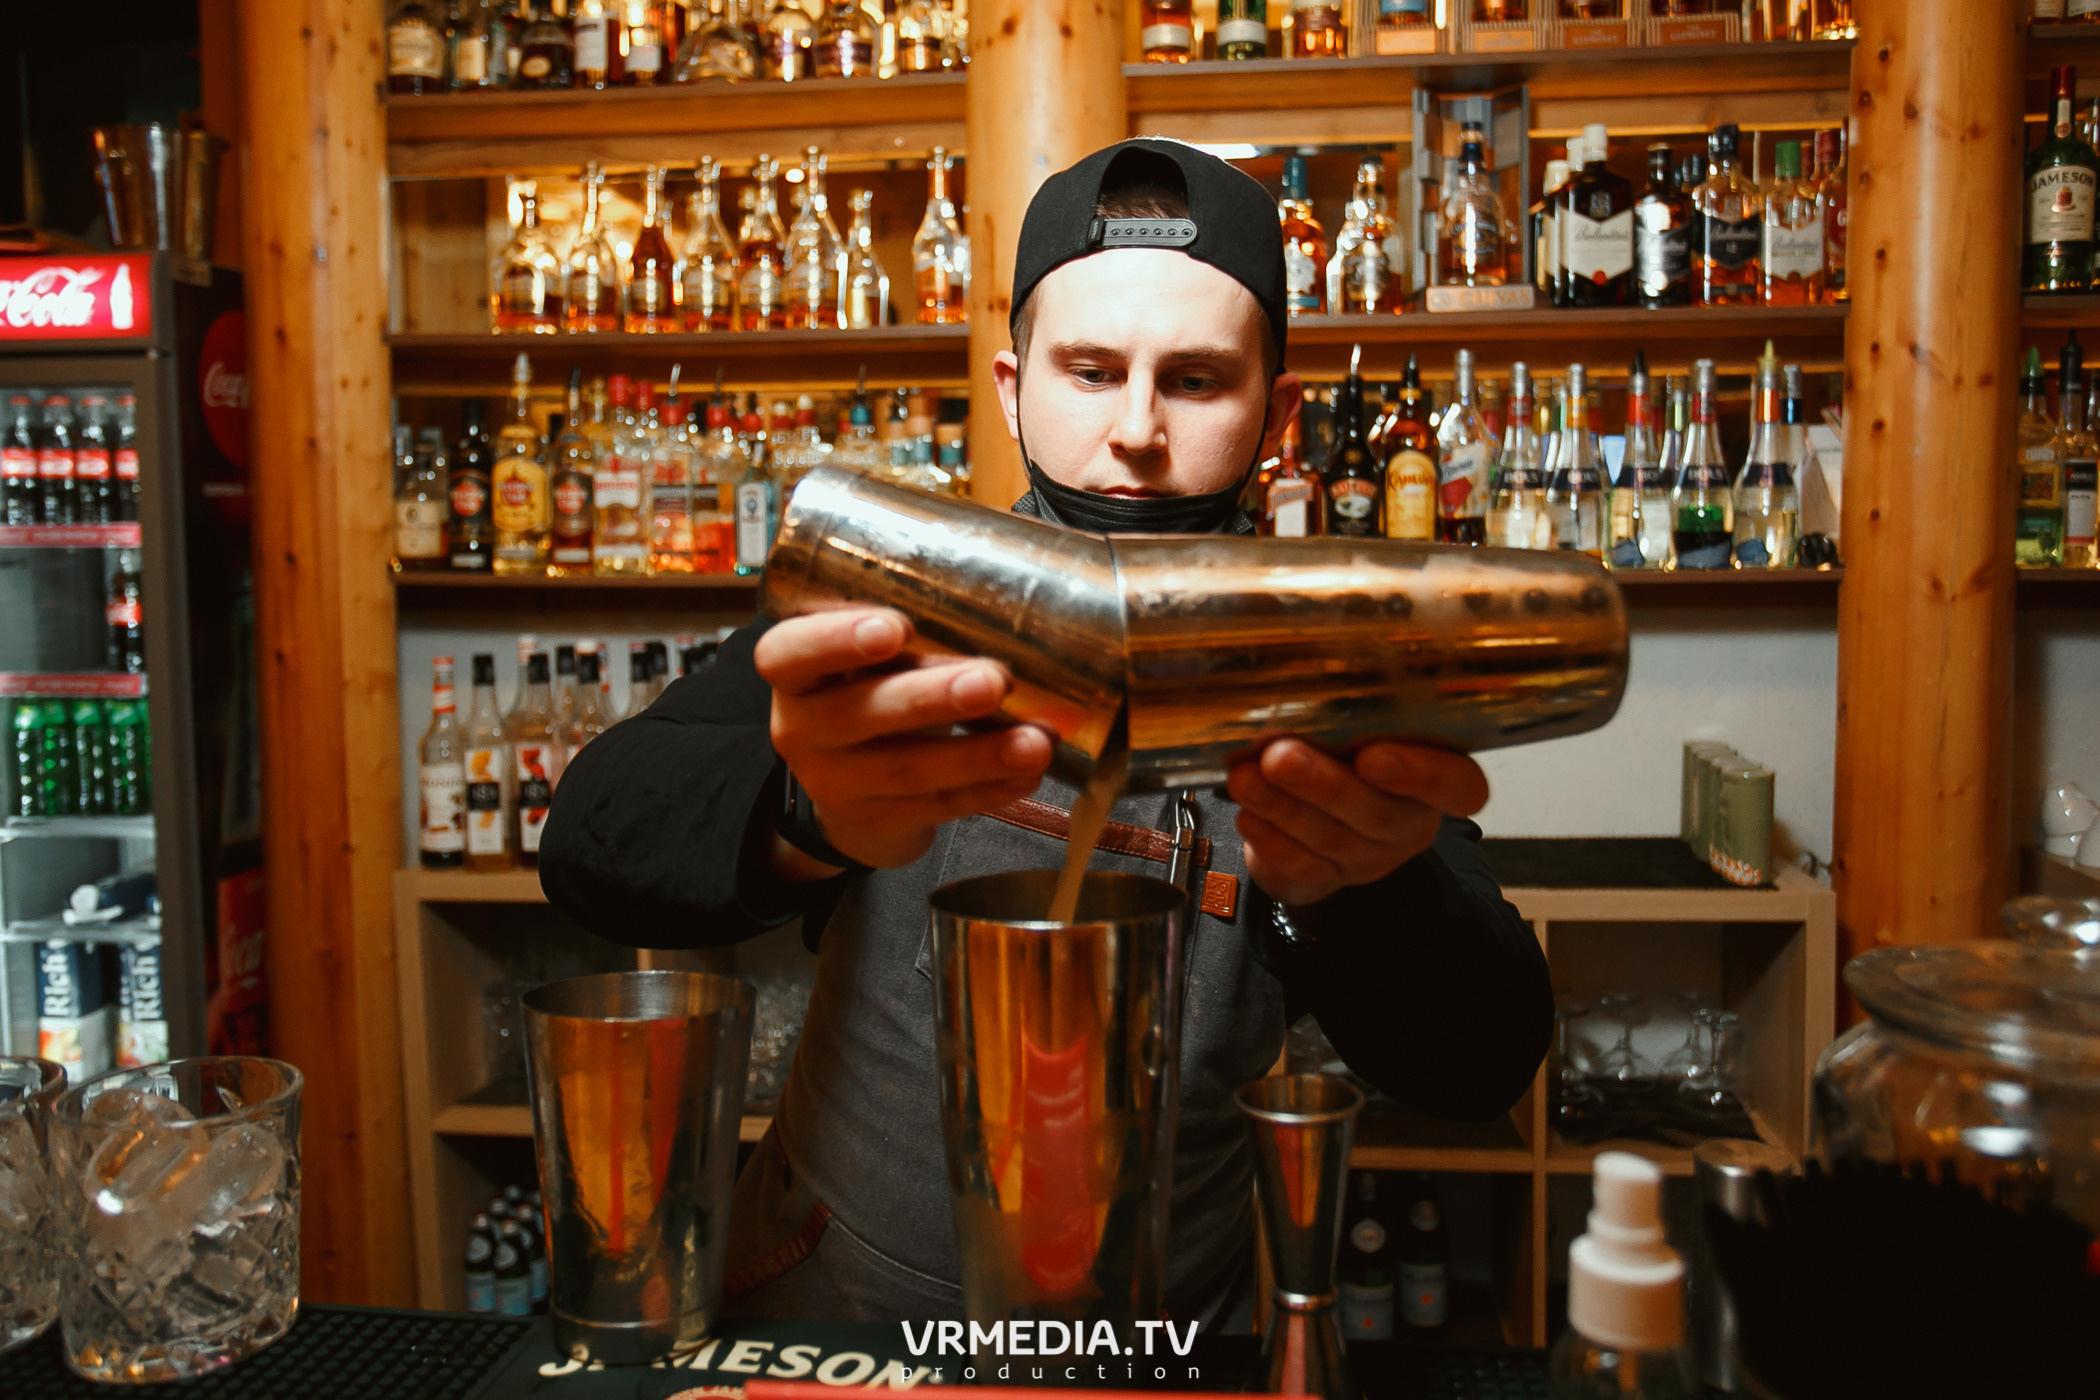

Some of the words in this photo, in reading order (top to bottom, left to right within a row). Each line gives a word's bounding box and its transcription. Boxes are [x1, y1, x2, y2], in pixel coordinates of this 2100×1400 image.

[2031, 172, 2095, 192] JAMESON
[1459, 289, 1530, 307] CHIVAS
[43, 953, 71, 1016] Rich
[131, 955, 160, 1020] Rich
[538, 1338, 932, 1391] JMESON
